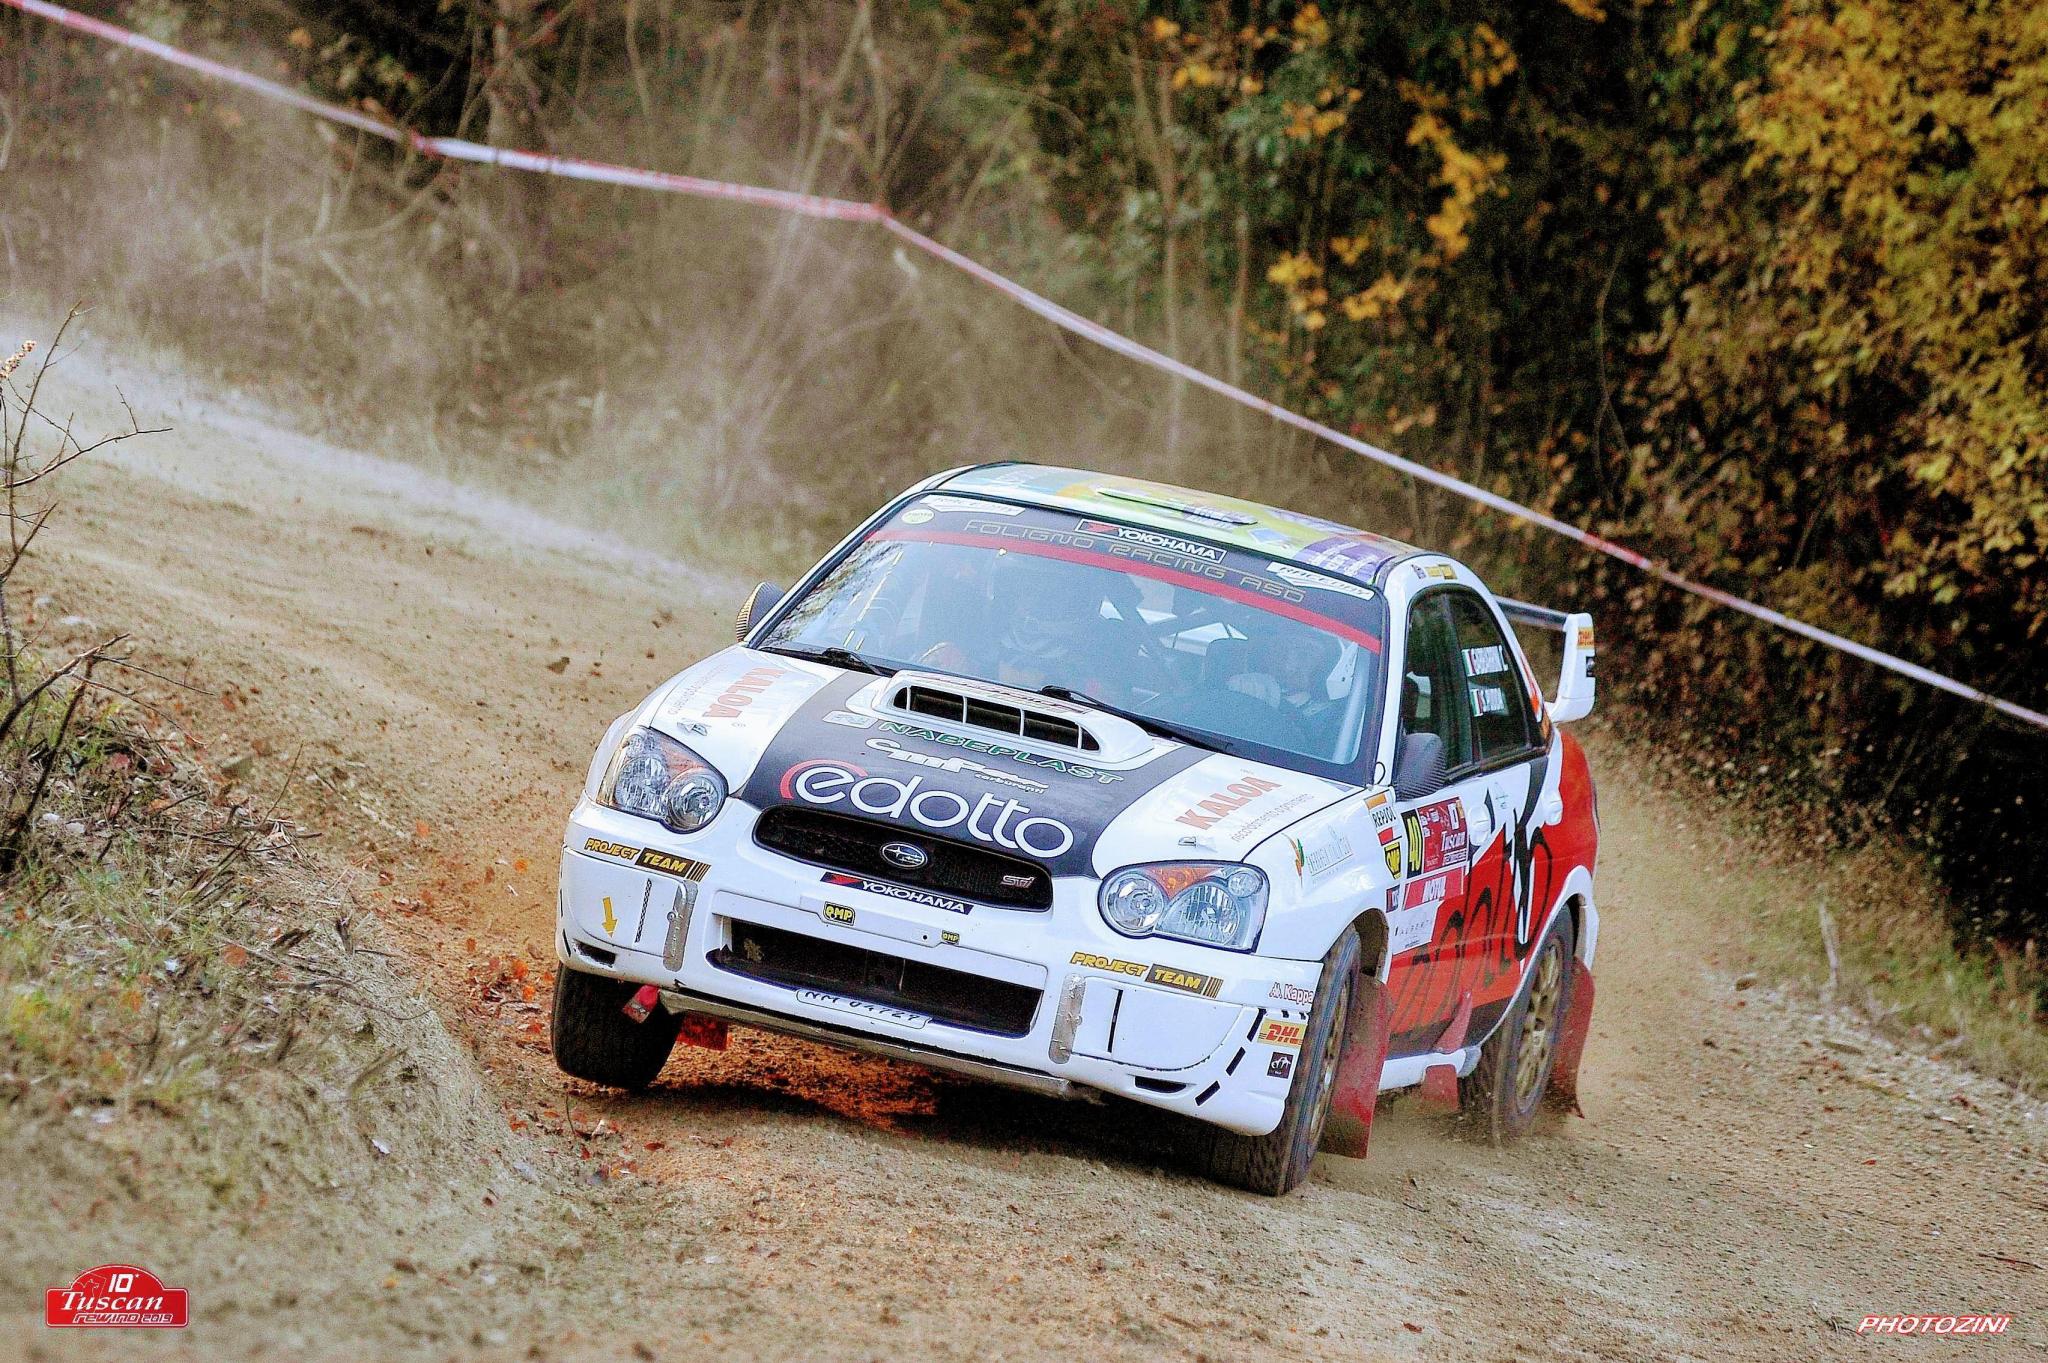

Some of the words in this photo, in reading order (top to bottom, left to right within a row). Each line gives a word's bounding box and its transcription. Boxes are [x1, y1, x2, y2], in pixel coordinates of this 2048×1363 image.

[963, 519, 1094, 549] FOLIGNO
[1108, 543, 1228, 580] RACING
[1240, 575, 1307, 603] ASD
[1116, 528, 1217, 560] YOKOHAMA
[878, 721, 1125, 785] NABEPLAST
[795, 765, 1075, 859] edotto
[1175, 776, 1282, 830] KALOA
[1373, 805, 1397, 828] REPSOL
[585, 837, 641, 861] PROJECT
[643, 852, 688, 873] TEAM
[825, 903, 853, 921] OMP
[861, 880, 966, 914] YOKOHAMA
[942, 931, 959, 942] OMP
[1070, 951, 1150, 978] PROJECT
[1153, 968, 1203, 991] TEAM
[1282, 983, 1315, 1005] Kappa
[1265, 1023, 1303, 1046] DHL
